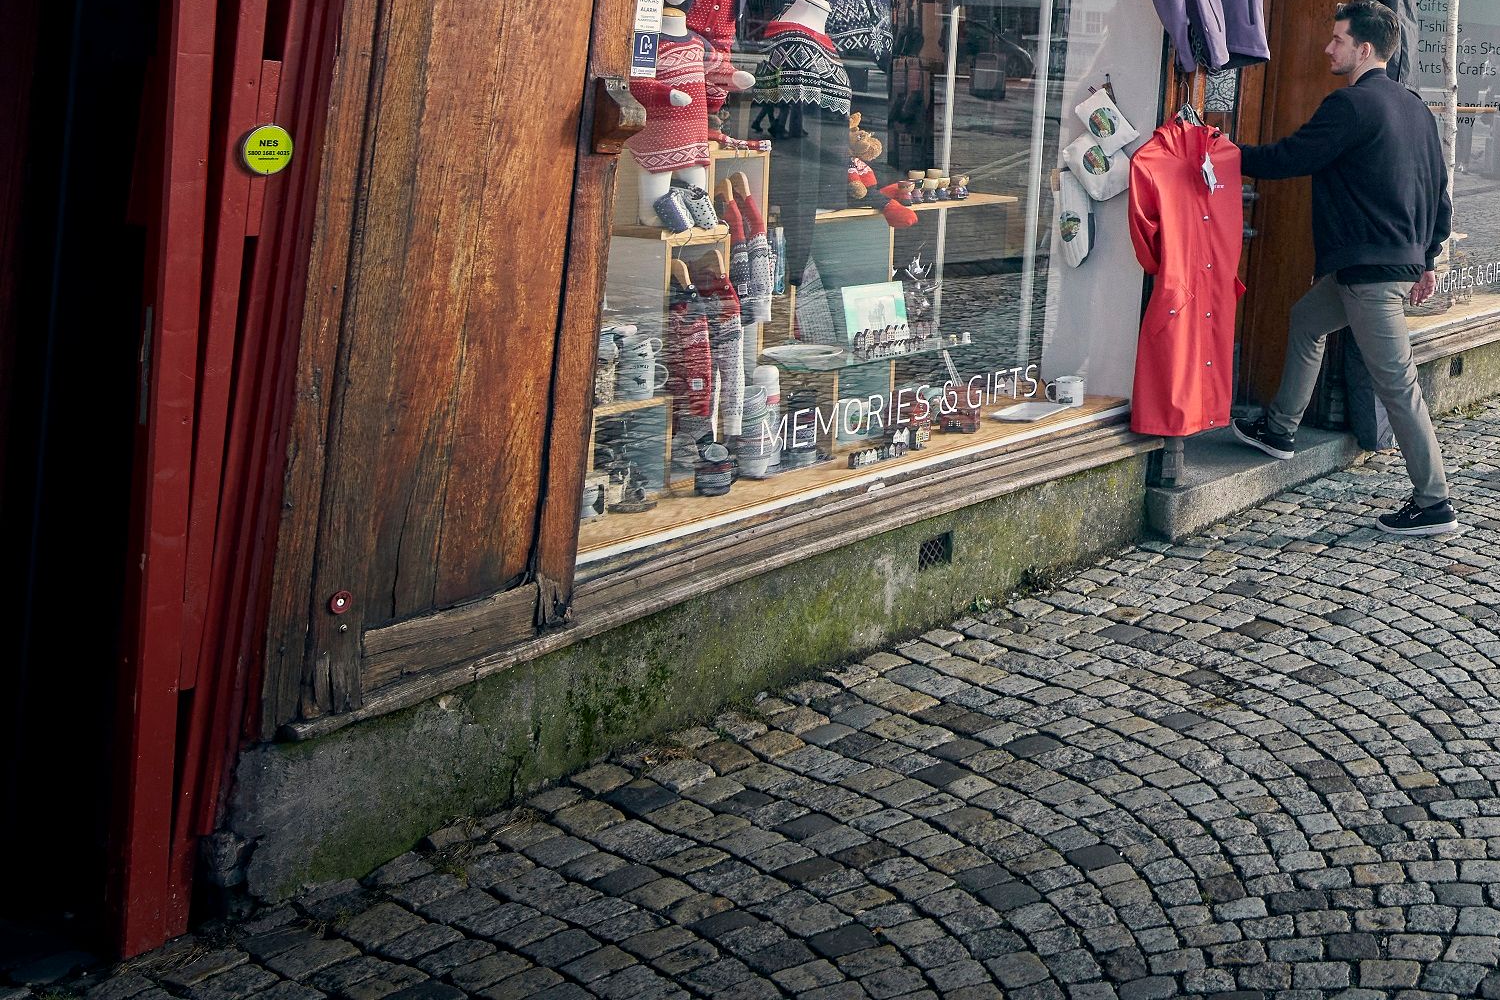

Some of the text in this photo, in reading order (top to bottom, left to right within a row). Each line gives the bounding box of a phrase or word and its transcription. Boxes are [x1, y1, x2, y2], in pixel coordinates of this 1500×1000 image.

[1458, 61, 1497, 76] Crafts
[259, 139, 279, 147] NES
[1475, 264, 1484, 286] &
[759, 363, 1039, 456] MEMORIES & GIFTS
